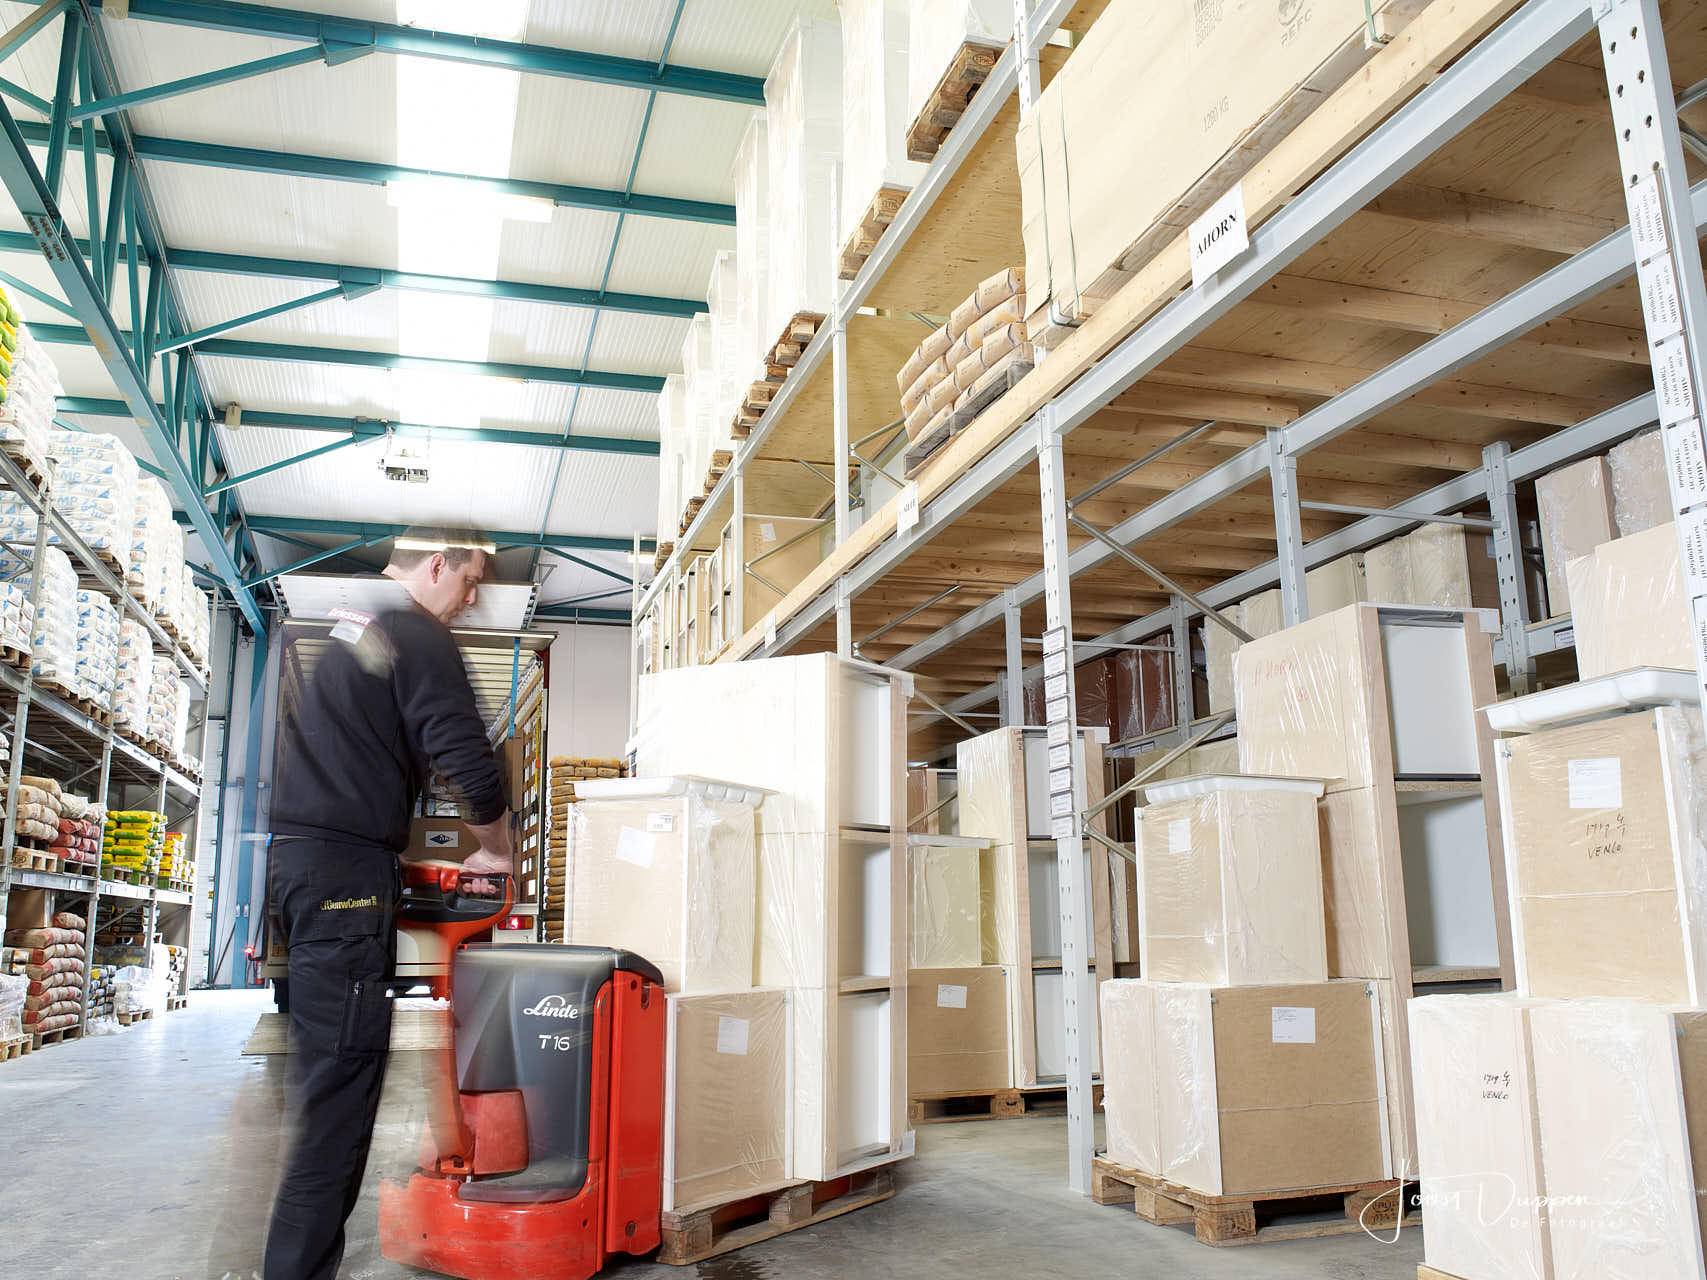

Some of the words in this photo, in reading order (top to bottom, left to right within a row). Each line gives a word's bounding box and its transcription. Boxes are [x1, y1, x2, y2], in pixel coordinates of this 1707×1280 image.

[1196, 208, 1237, 259] AHORN
[1587, 840, 1622, 859] VENLO
[523, 994, 579, 1019] Linde
[1482, 1090, 1509, 1100] VENLO
